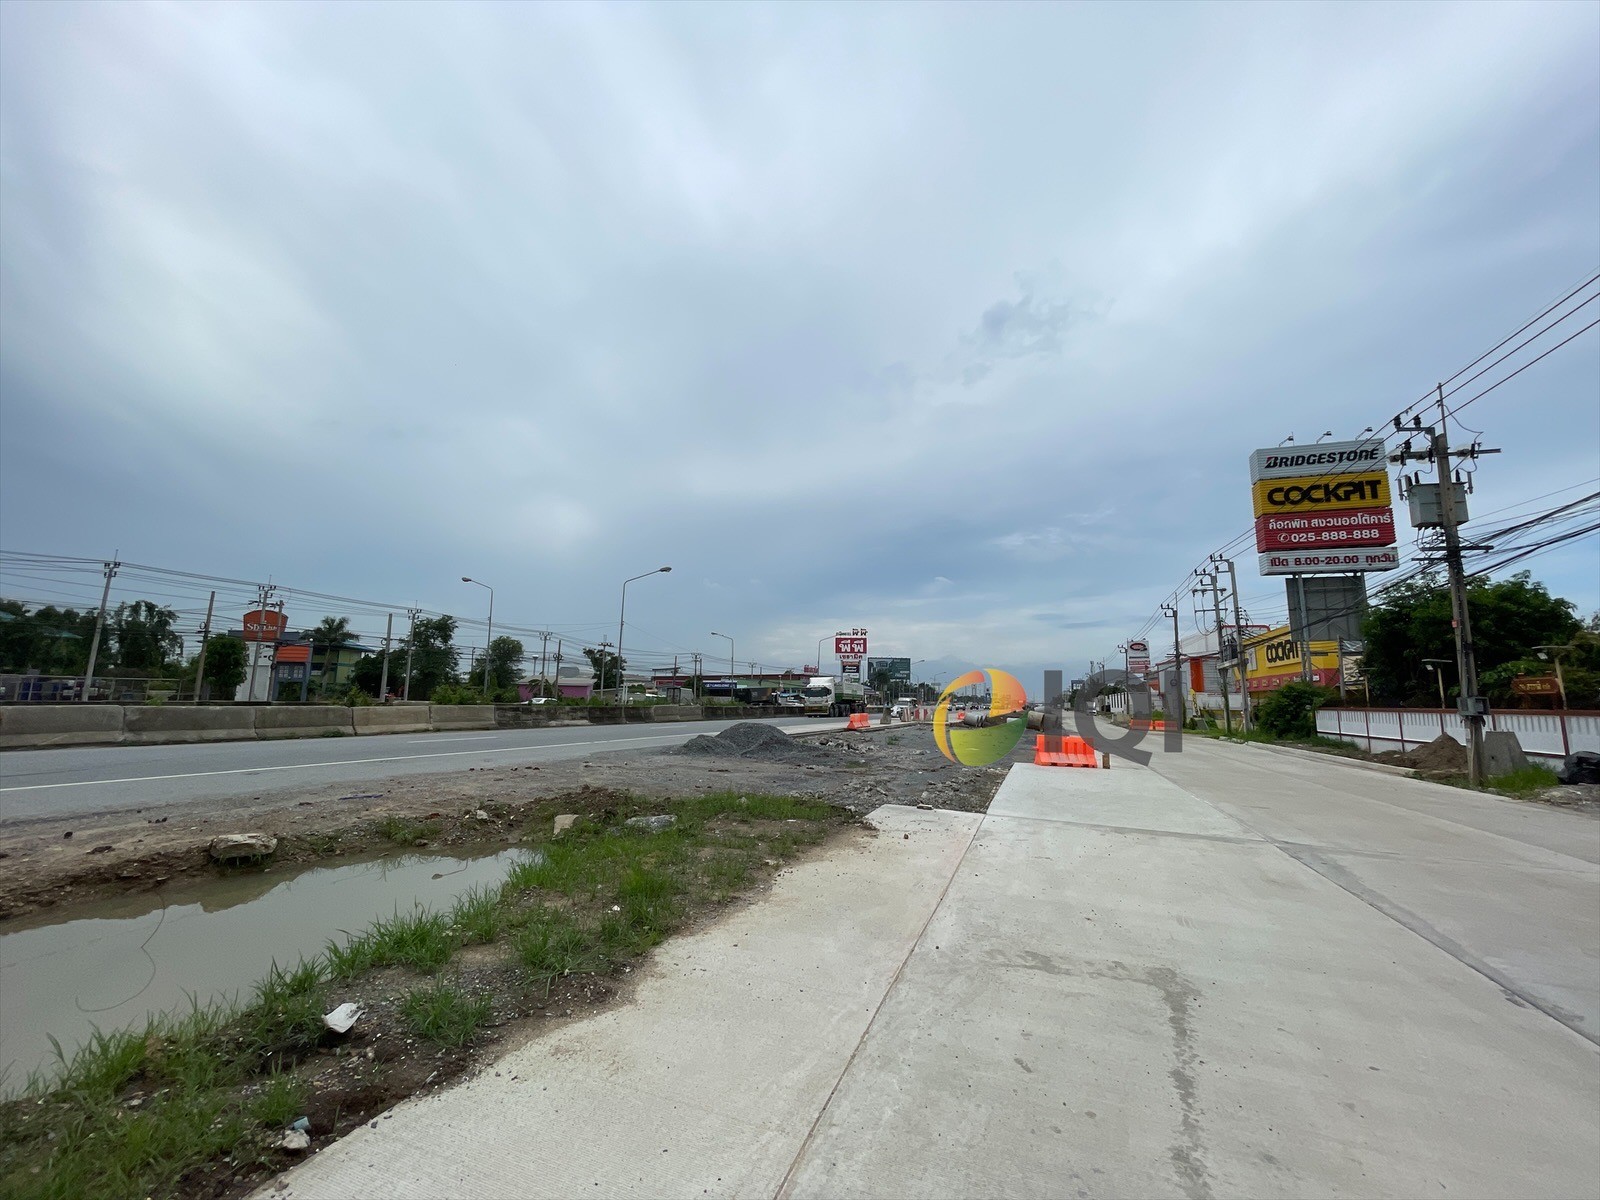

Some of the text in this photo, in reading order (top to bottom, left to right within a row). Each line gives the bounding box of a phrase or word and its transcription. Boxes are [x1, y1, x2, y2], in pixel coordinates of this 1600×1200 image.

[1265, 448, 1379, 469] BRIDGESTONE
[1267, 479, 1382, 506] COCKPIT
[1291, 529, 1379, 542] 025-888-888
[1270, 553, 1396, 567] เปิด 8.00-20.00 ทุกวัน
